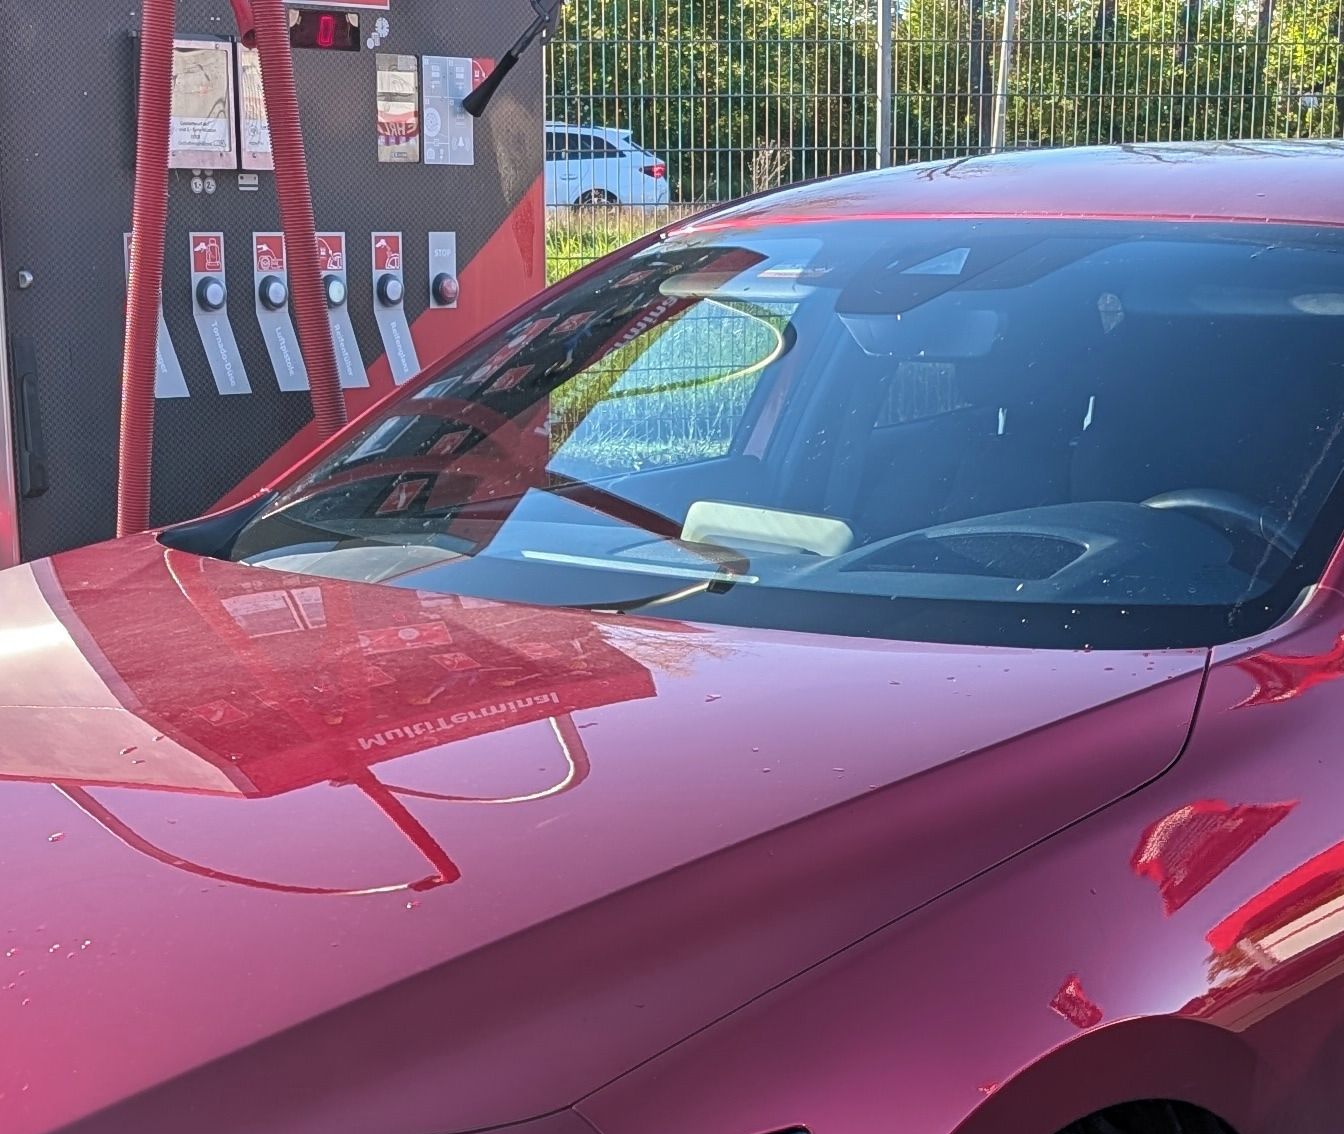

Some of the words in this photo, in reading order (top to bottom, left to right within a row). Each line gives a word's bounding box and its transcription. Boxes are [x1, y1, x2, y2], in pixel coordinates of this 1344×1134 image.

[433, 248, 452, 257] STOP
[274, 325, 295, 377] Luftpistole
[389, 320, 409, 374] Reifenglanz
